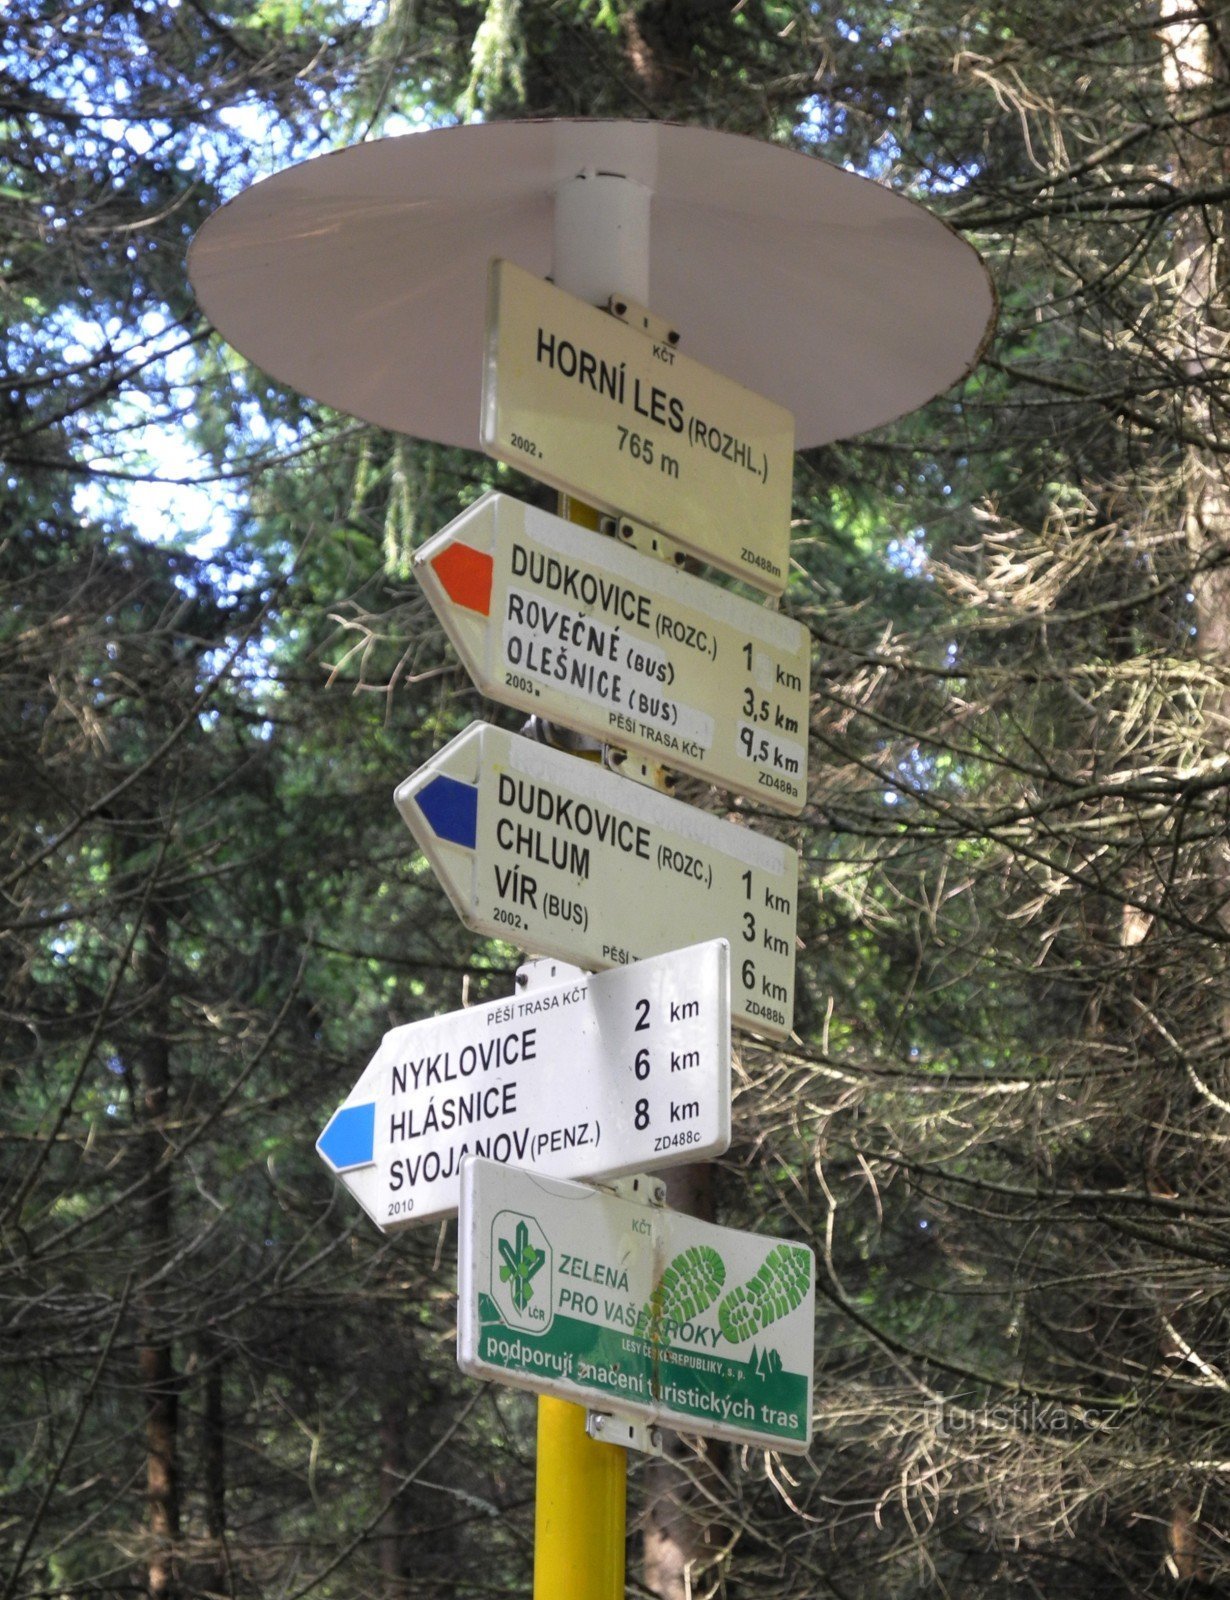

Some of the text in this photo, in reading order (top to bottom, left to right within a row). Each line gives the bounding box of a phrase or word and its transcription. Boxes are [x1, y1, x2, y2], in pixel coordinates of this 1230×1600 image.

[653, 345, 676, 366] KČT
[536, 328, 768, 484] HORNÍ LES (ROZHL.)
[617, 425, 680, 479] 765 m
[740, 547, 781, 578] ZD488m
[511, 543, 801, 692] DUDKOVICE (ROZC.) 1 km
[507, 593, 799, 733] ROVEČNÉ (BUS) 3,5 km
[507, 636, 799, 774] OLEŠNICE (BUS) 9,5 km
[639, 723, 679, 750] TRASA
[682, 740, 705, 760] KČT
[498, 773, 791, 915] DUDKOVICE (ROZC.) 1 km
[496, 818, 789, 956] CHLUM 3 km
[494, 864, 788, 1004] VÍR (BUS) 6 km
[602, 944, 629, 965] PĚŠÍ
[487, 986, 588, 1026] PĚŠÍ TRASA KČT
[745, 999, 785, 1025] ZD488b
[391, 998, 700, 1096] NYKLOVICE 2 km
[389, 1048, 700, 1144] HLÁSNICE 6 km
[530, 1120, 601, 1162] (PENZ.)
[634, 1098, 650, 1131] 8
[670, 1100, 700, 1123] km
[654, 1131, 701, 1152] ZD488c
[388, 1198, 414, 1216] 2010
[632, 1218, 652, 1236] KČT
[558, 1254, 629, 1292] ZELENÁ
[528, 1305, 545, 1321] LČR
[559, 1288, 598, 1317] PRO
[604, 1301, 649, 1331] VAŠE
[622, 1339, 642, 1355] LESY
[643, 1342, 669, 1363] ČEKÉ
[487, 1337, 573, 1377] podporují
[577, 1361, 643, 1393] značení
[760, 1406, 798, 1428] tras
